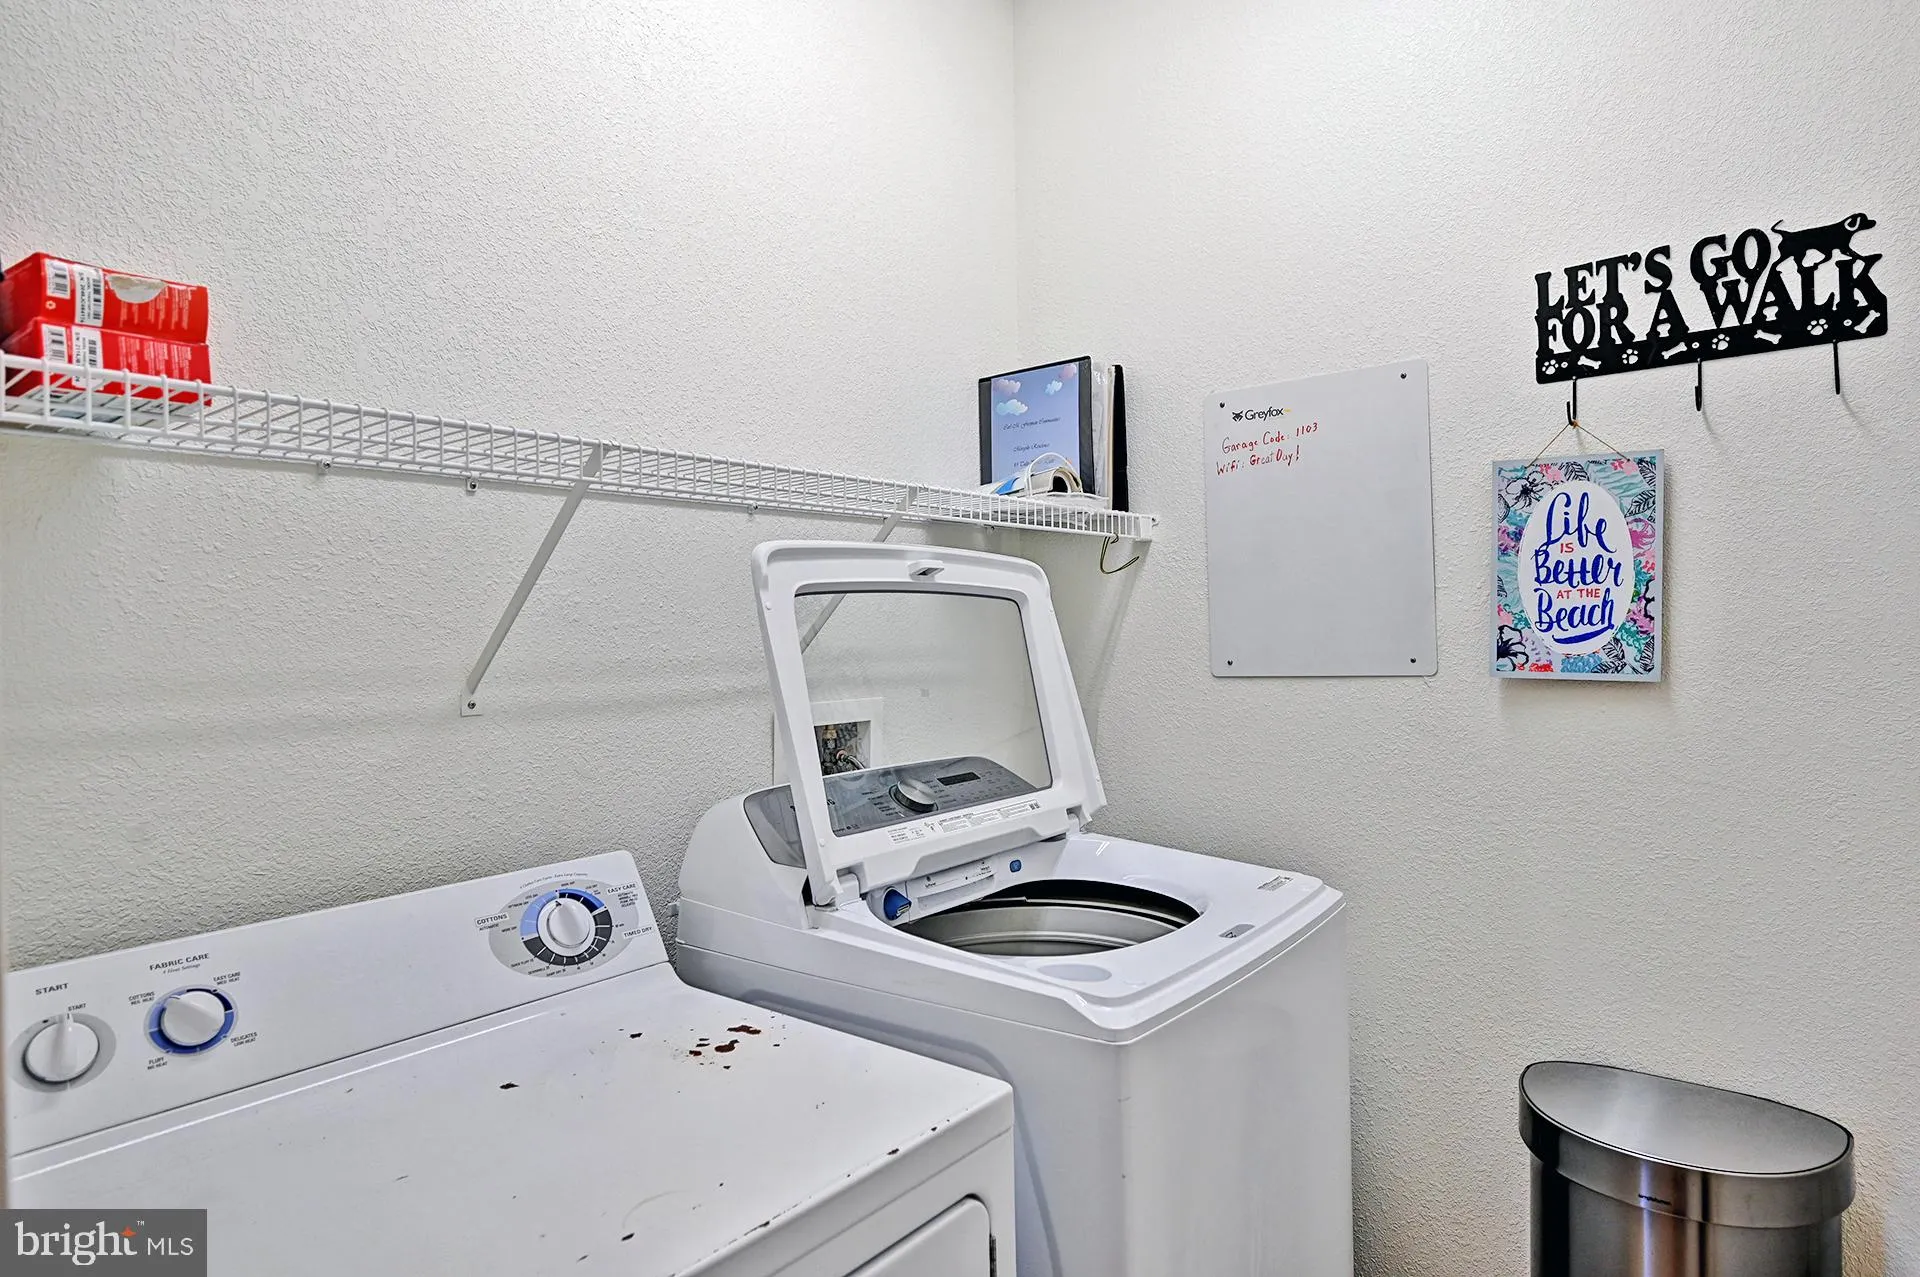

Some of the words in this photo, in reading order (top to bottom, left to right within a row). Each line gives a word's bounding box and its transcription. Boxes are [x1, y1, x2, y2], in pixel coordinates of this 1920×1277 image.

[1535, 245, 1673, 309] LET'S
[1690, 228, 1771, 286] GO
[1535, 296, 1637, 356] FOR
[1647, 289, 1689, 341] A
[1700, 254, 1887, 329] WALK
[1245, 406, 1284, 421] Greyfox
[1222, 437, 1258, 454] Garage
[1296, 422, 1318, 437] 1103
[1538, 492, 1617, 553] Life
[1560, 542, 1575, 554] IS
[1533, 549, 1624, 587] Better
[1556, 590, 1573, 600] AT
[1577, 588, 1601, 599] THE
[1533, 587, 1615, 635] Beach
[476, 913, 508, 925] COTTONS
[624, 928, 641, 937] TIMED
[641, 926, 653, 934] DRY
[149, 958, 184, 971] FABRIC
[185, 953, 210, 963] CARE
[213, 974, 227, 982] EASY
[227, 971, 241, 979] CARE
[35, 982, 69, 996] START
[128, 991, 155, 1001] COTTONS
[67, 1003, 87, 1012] START
[230, 1032, 258, 1043] DELICATES
